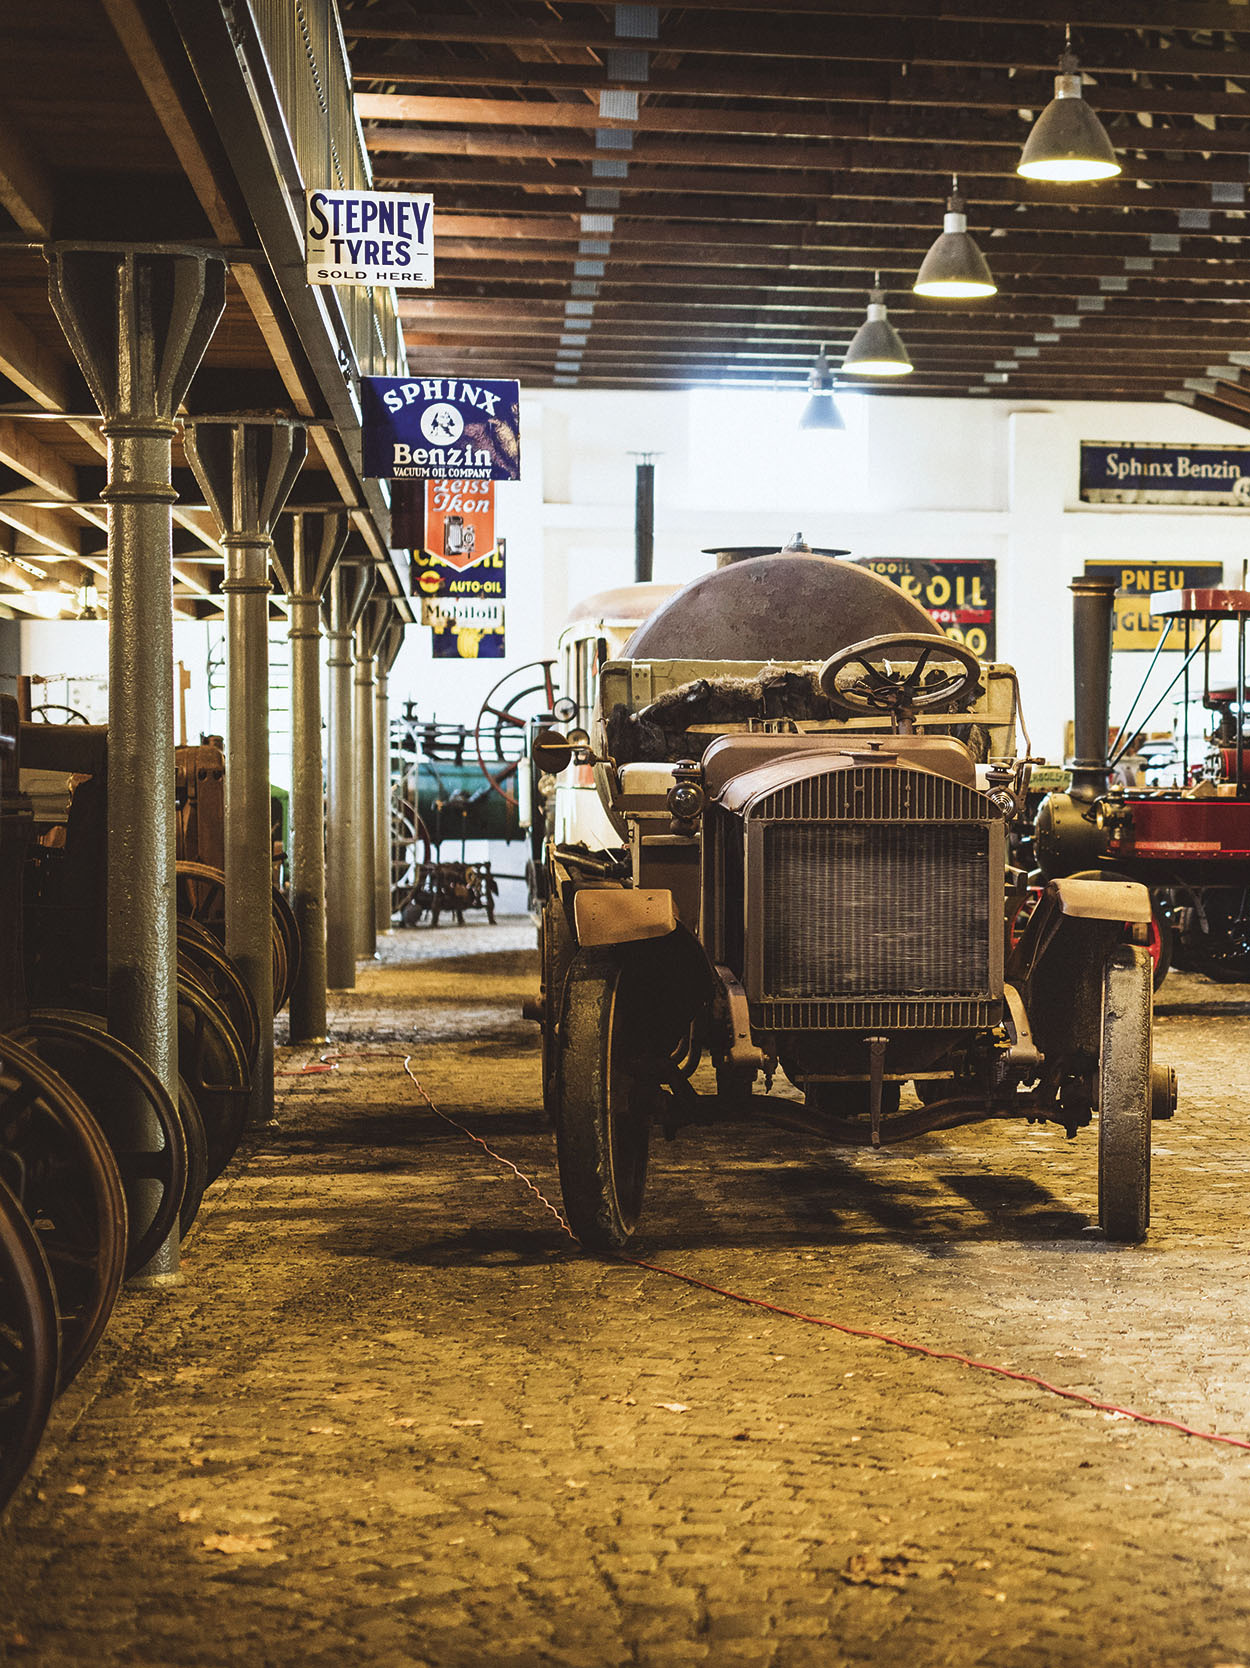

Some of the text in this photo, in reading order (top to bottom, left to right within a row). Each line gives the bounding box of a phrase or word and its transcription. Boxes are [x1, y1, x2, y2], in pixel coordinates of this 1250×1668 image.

[309, 193, 430, 245] STEPNEY
[330, 239, 411, 266] TYRES
[317, 270, 427, 282] SOLD HERE.
[383, 380, 501, 416] SPHINX
[393, 444, 492, 467] Benzin
[1106, 453, 1240, 479] Sphinx Benzin
[393, 467, 492, 479] VACUUM OIL COMPANY
[433, 492, 490, 513] Ikon
[1122, 570, 1184, 590] PNEU
[426, 605, 497, 618] Mobiloil
